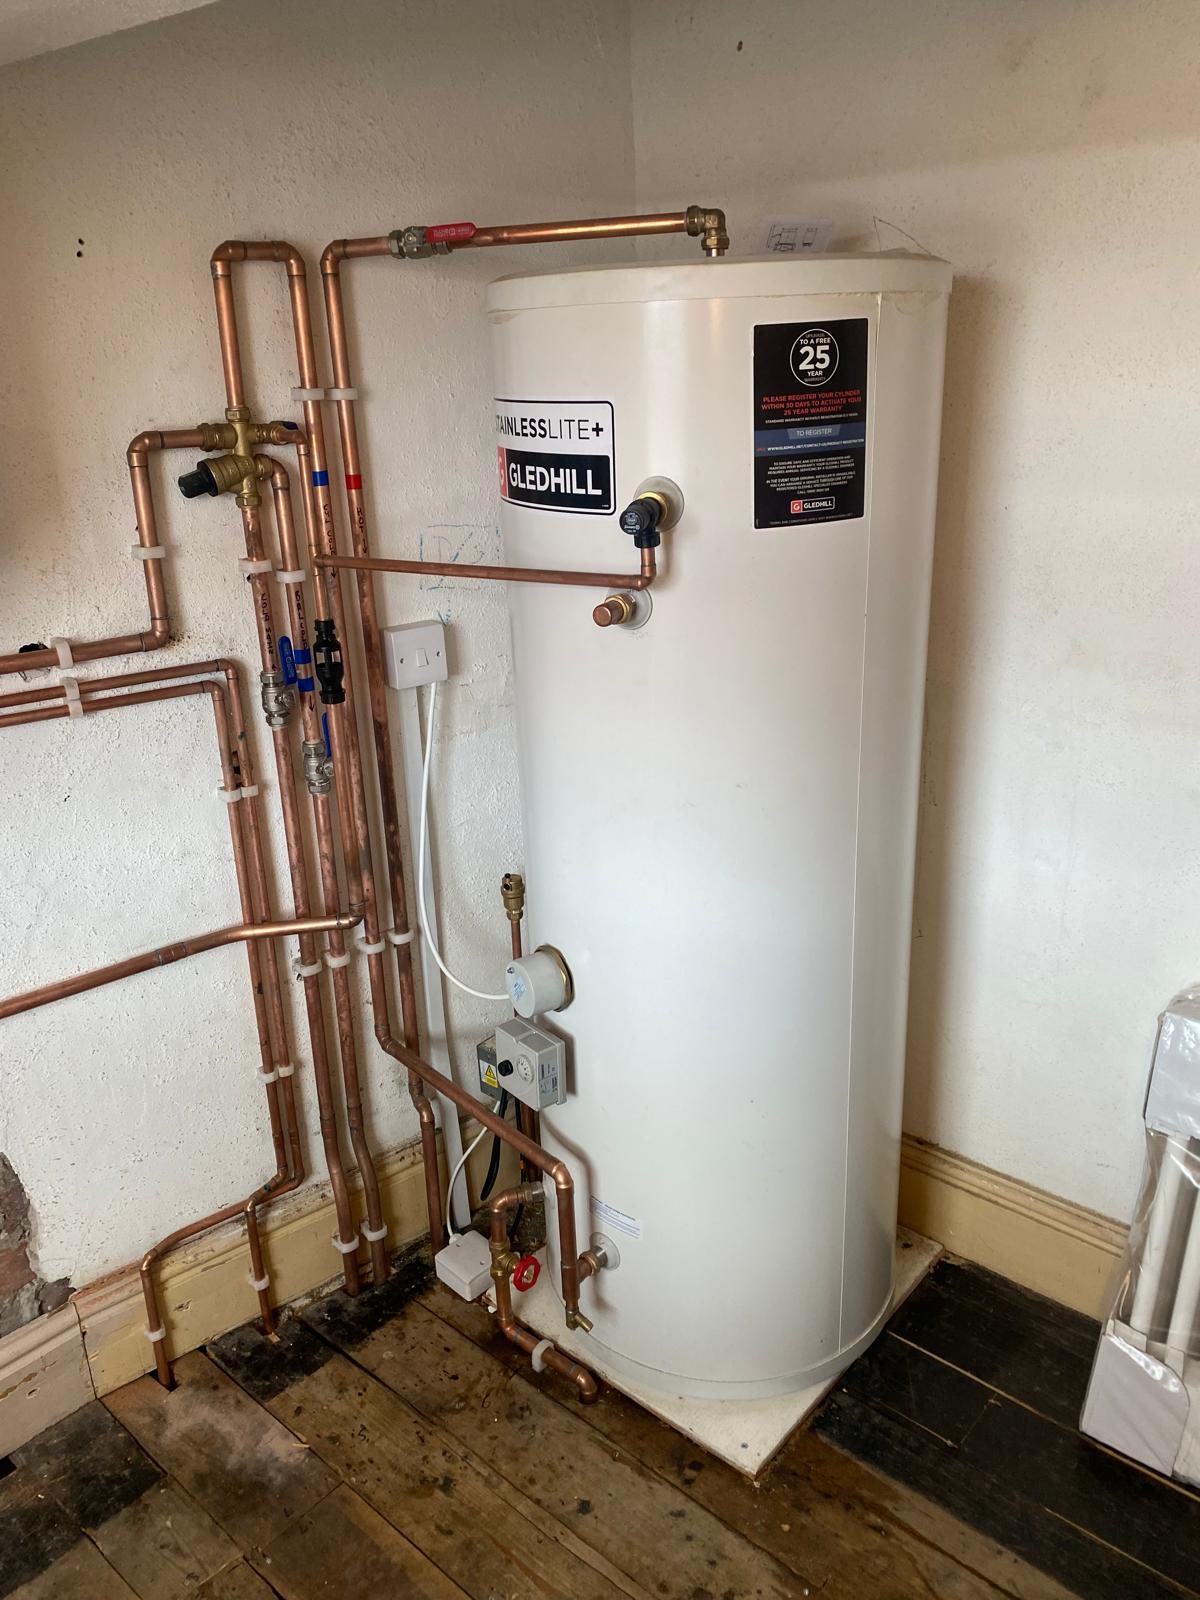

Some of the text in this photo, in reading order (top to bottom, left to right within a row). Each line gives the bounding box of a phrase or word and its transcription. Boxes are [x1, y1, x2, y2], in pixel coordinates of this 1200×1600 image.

[799, 345, 831, 370] 25
[810, 406, 842, 414] WARRANTY
[496, 415, 604, 440] TAINLESSLITE+
[806, 428, 832, 436] REGISTER
[509, 462, 602, 495] GLEDHILL
[803, 500, 832, 509] GLEDHILL
[356, 506, 364, 533] HOT
